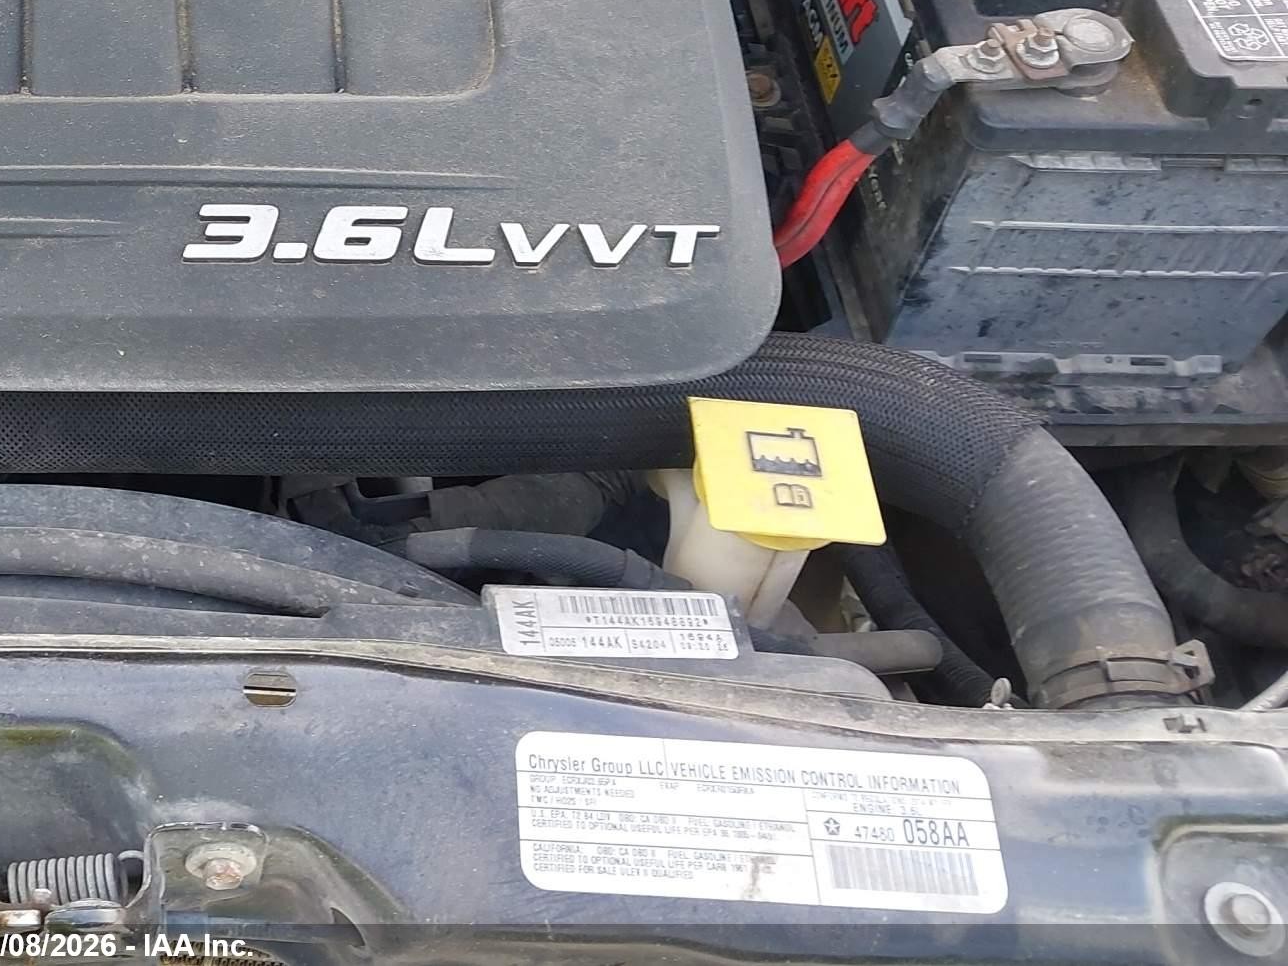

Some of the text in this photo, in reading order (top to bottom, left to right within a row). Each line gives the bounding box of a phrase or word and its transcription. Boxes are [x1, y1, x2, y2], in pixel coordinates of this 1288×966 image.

[181, 204, 721, 268] 3.6L VVT
[511, 600, 542, 646] 144AK
[582, 635, 621, 648] 144AK
[529, 754, 664, 776] Chrysler Group LLC
[671, 762, 960, 794] VEHICLE EMISSION CONTROL INFORMATION
[902, 818, 971, 847] 058AA
